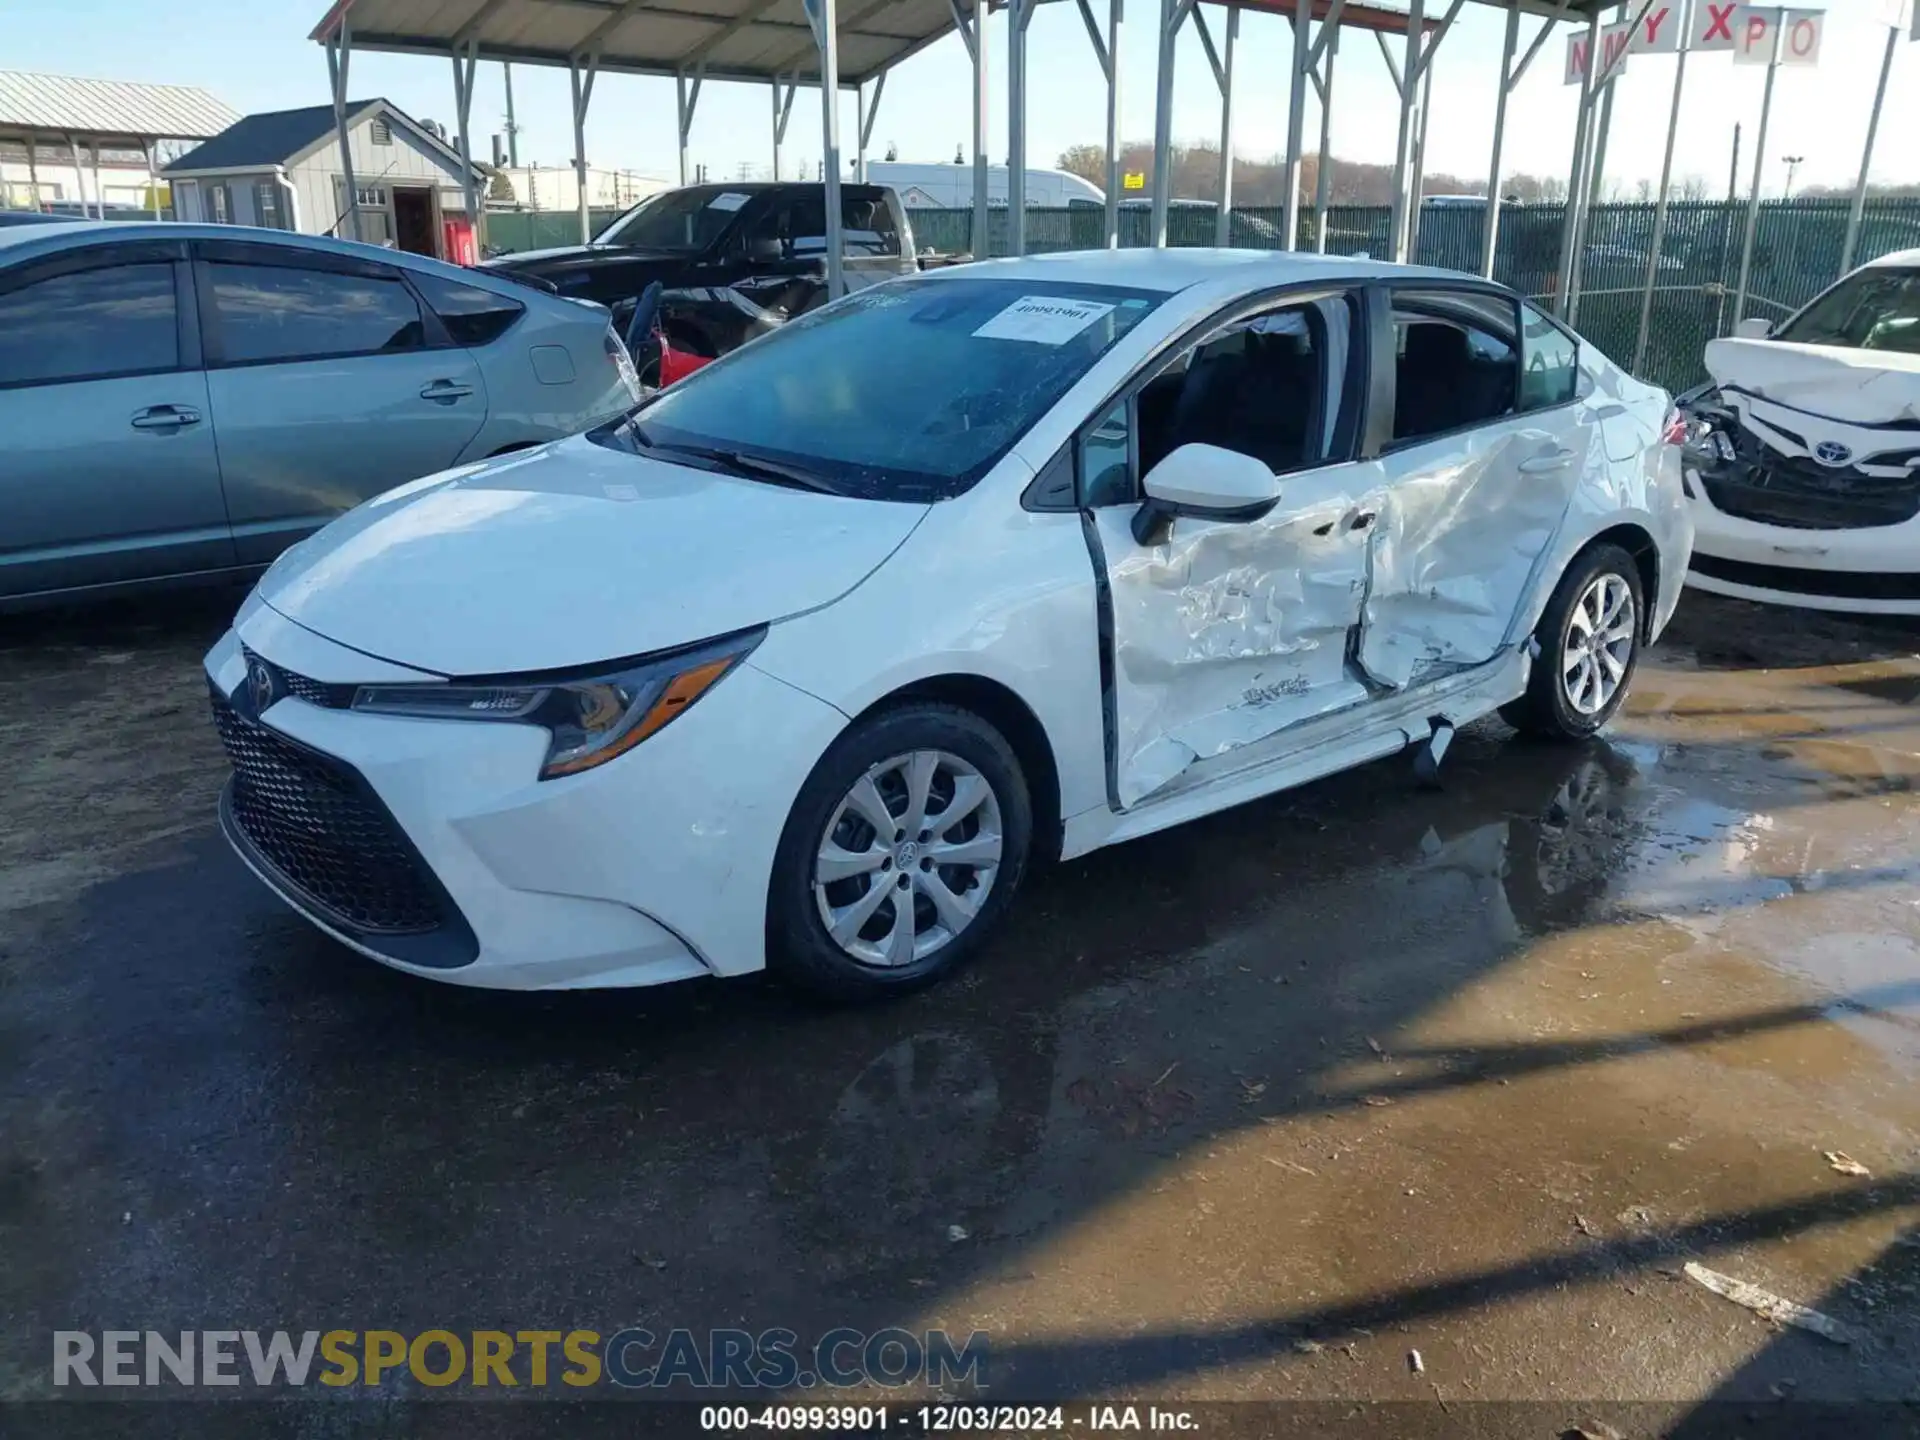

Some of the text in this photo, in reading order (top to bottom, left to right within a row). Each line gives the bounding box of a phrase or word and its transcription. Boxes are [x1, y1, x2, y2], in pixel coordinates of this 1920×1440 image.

[1646, 8, 1670, 43] Y
[1703, 3, 1737, 41] X
[1746, 16, 1767, 55] P
[1791, 18, 1815, 56] O
[1572, 40, 1589, 76] N
